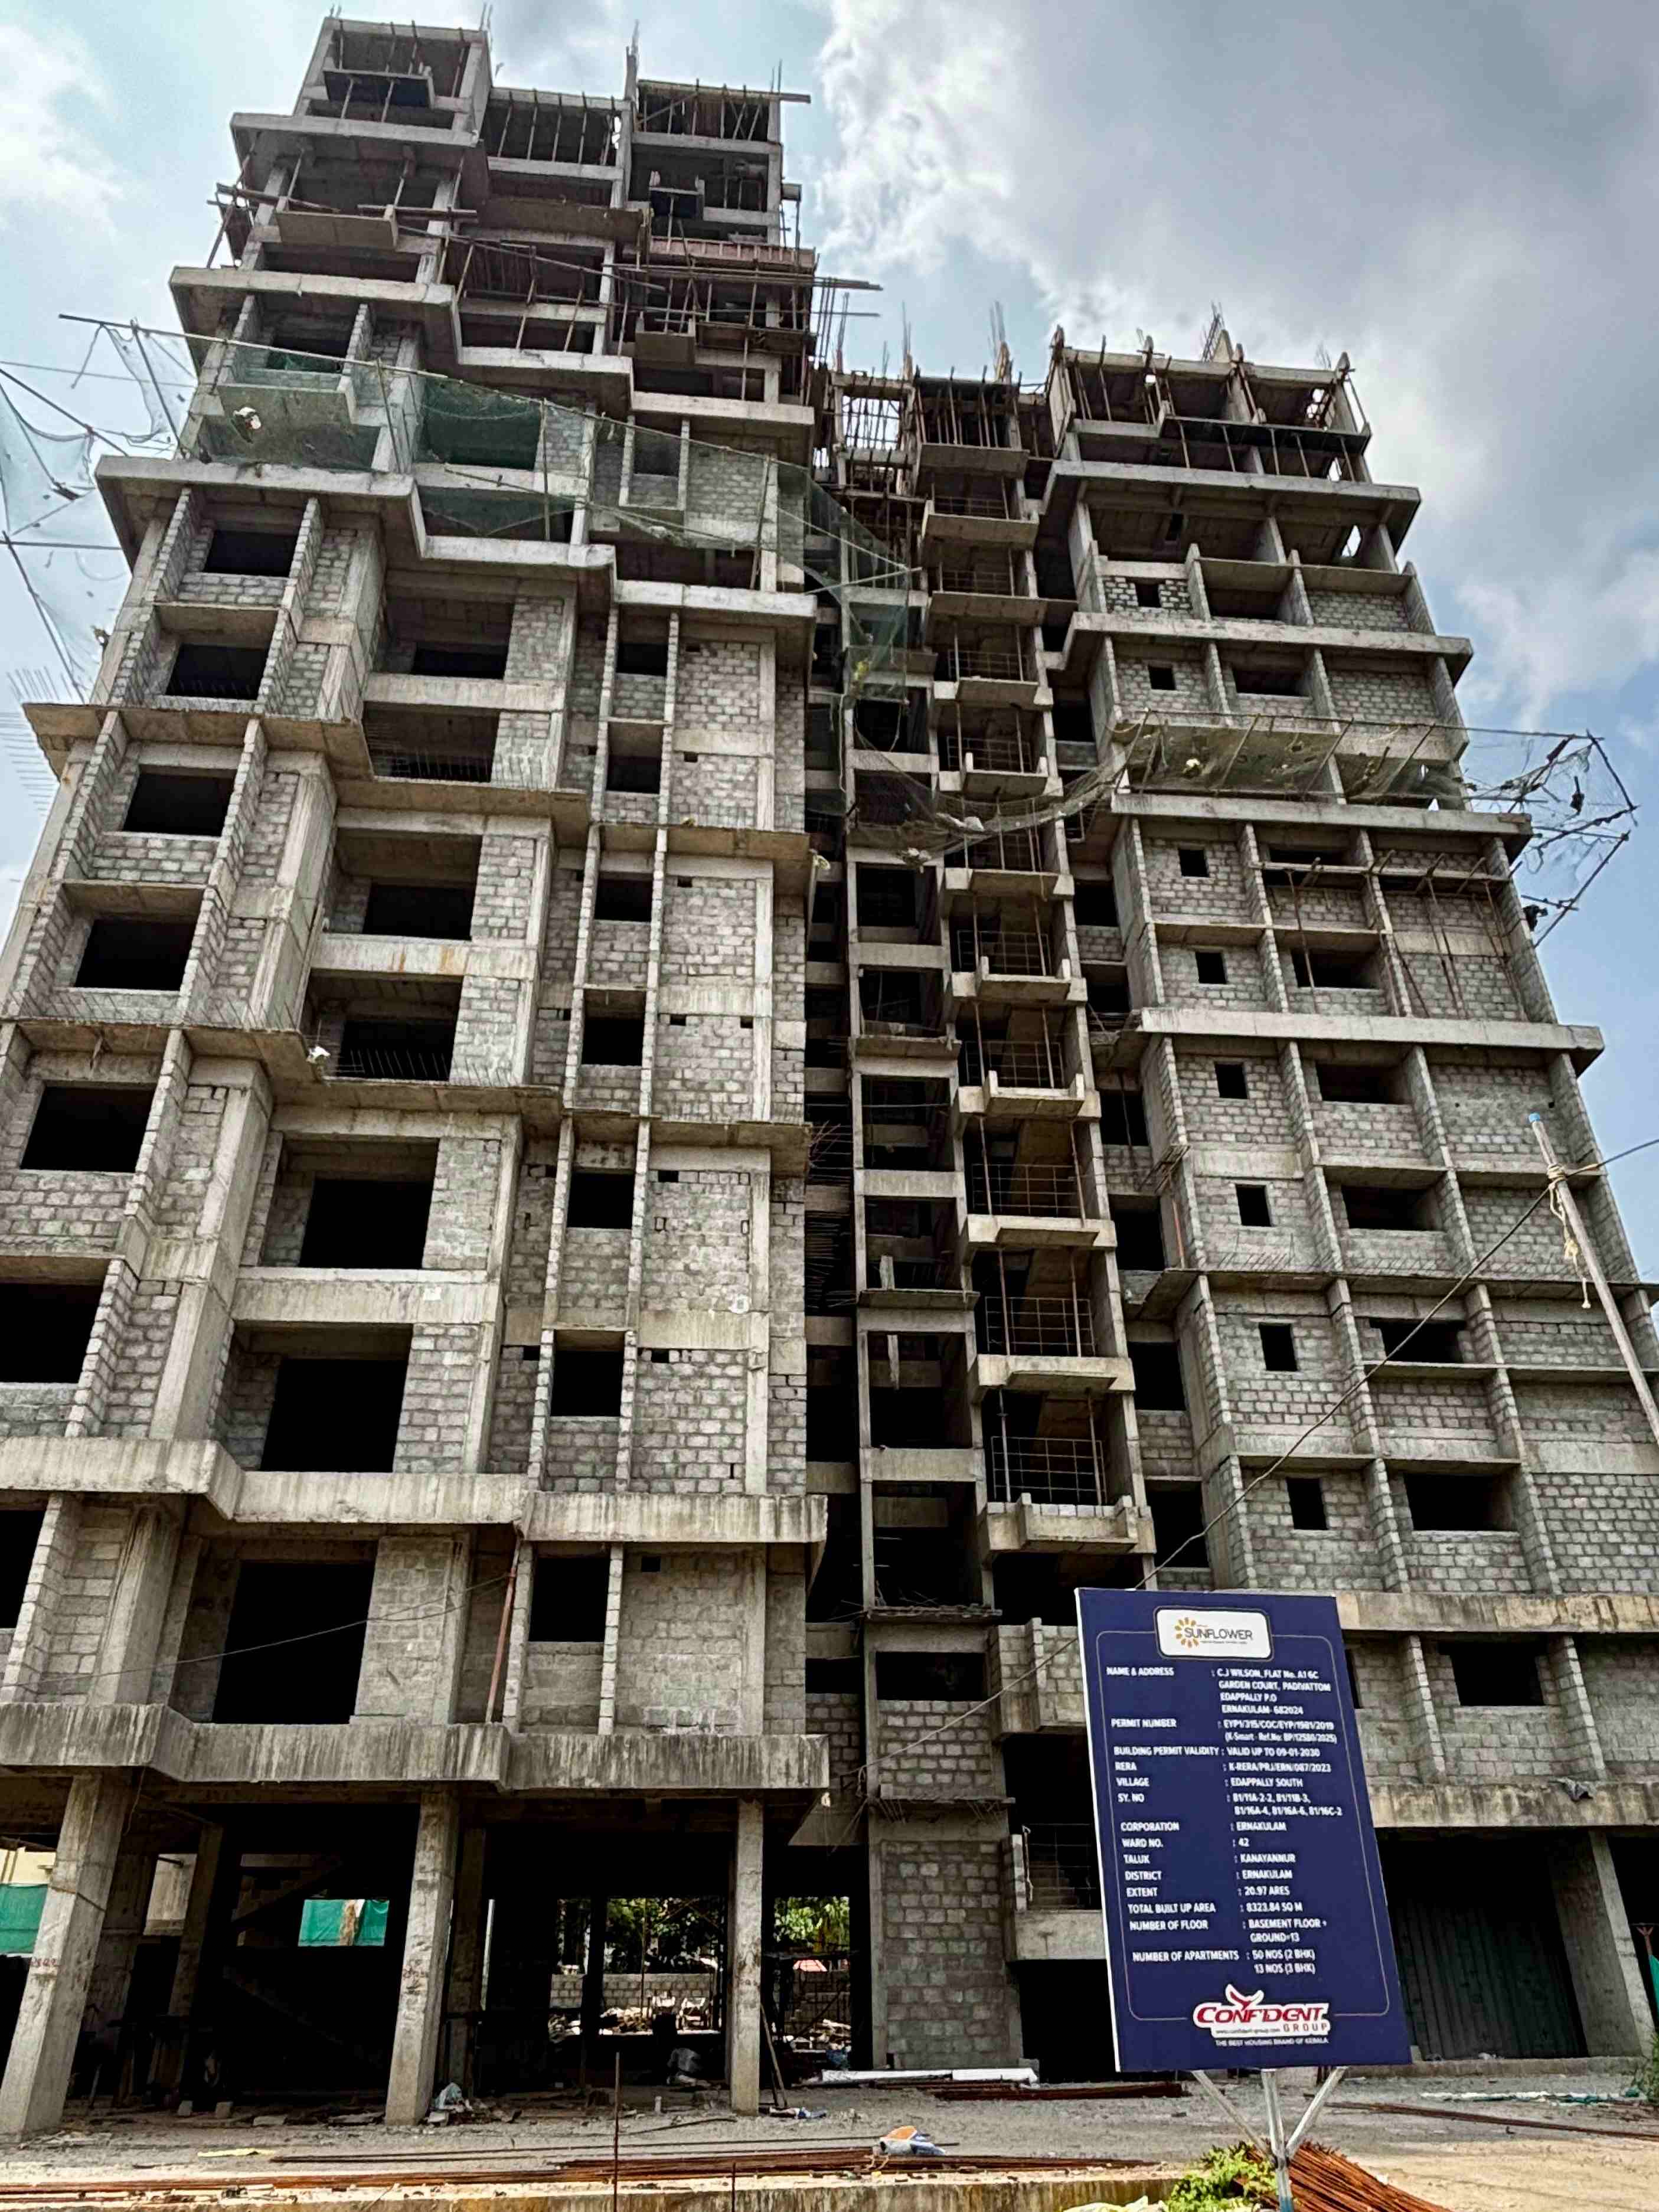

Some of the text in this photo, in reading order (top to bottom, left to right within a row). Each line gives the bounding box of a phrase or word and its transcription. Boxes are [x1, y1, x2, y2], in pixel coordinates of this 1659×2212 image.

[1184, 1628, 1253, 1640] SUNFLOWER
[1106, 1667, 1129, 1676] NAME
[1131, 1667, 1137, 1676] &
[1138, 1667, 1174, 1676] ADDRESS
[1263, 1669, 1282, 1678] FLAT
[1219, 1681, 1250, 1689] GARDEN
[1252, 1681, 1281, 1691] COURT,
[1220, 1693, 1262, 1701] EDAPPALLY
[1111, 1718, 1141, 1727] PERMIT
[1142, 1718, 1177, 1727] NUMBER
[1113, 1746, 1152, 1756] BUILDING
[1153, 1746, 1183, 1755] PERMIT
[1184, 1746, 1219, 1756] VALIDITY
[1226, 1747, 1250, 1756] VALID
[1251, 1747, 1262, 1756] UP
[1264, 1747, 1275, 1756] TO
[1115, 1762, 1137, 1771] RERA
[1116, 1778, 1150, 1787] VILLAGE
[1230, 1778, 1273, 1787] EDAPPALLY
[1275, 1778, 1303, 1787] SOUTH
[1118, 1793, 1130, 1802] SY.
[1132, 1793, 1144, 1802] NO
[1121, 1822, 1180, 1831] CORPORATION
[1236, 1822, 1287, 1831] ERNAKULAM
[1122, 1838, 1147, 1848] WARD
[1148, 1838, 1163, 1848] NO.
[1238, 1837, 1250, 1847] 42
[1123, 1854, 1150, 1864] TALUK
[1240, 1854, 1296, 1863] KANAYANNUR
[1125, 1871, 1162, 1880] DISTRICT
[1242, 1870, 1292, 1880] ERNAKULAM
[1126, 1887, 1158, 1897] EXTENT
[1244, 1886, 1267, 1896] 20.97
[1269, 1886, 1290, 1896] ARES
[1128, 1904, 1154, 1914] TOTAL
[1155, 1903, 1178, 1913] BUILT
[1180, 1903, 1192, 1913] UP
[1193, 1903, 1216, 1913] AREA
[1281, 1902, 1294, 1912] SQ
[1294, 1902, 1303, 1912] M
[1129, 1920, 1166, 1931] NUMBER
[1167, 1920, 1179, 1930] OF
[1181, 1920, 1209, 1930] FLOOR
[1248, 1919, 1292, 1929] BASEMENT
[1294, 1918, 1321, 1928] FLOOR
[1132, 1951, 1170, 1962] NUMBER
[1171, 1951, 1183, 1961] OF
[1184, 1950, 1239, 1961] APARTMENTS
[1252, 1949, 1264, 1959] 50
[1265, 1949, 1284, 1959] NOS
[1284, 1949, 1293, 1961] (2
[1294, 1949, 1315, 1961] BHK)
[1254, 1963, 1315, 1975] 13 NOS (3 BHK)
[1196, 2007, 1324, 2024] CONFIDENT
[1283, 2023, 1328, 2033] GROUP
